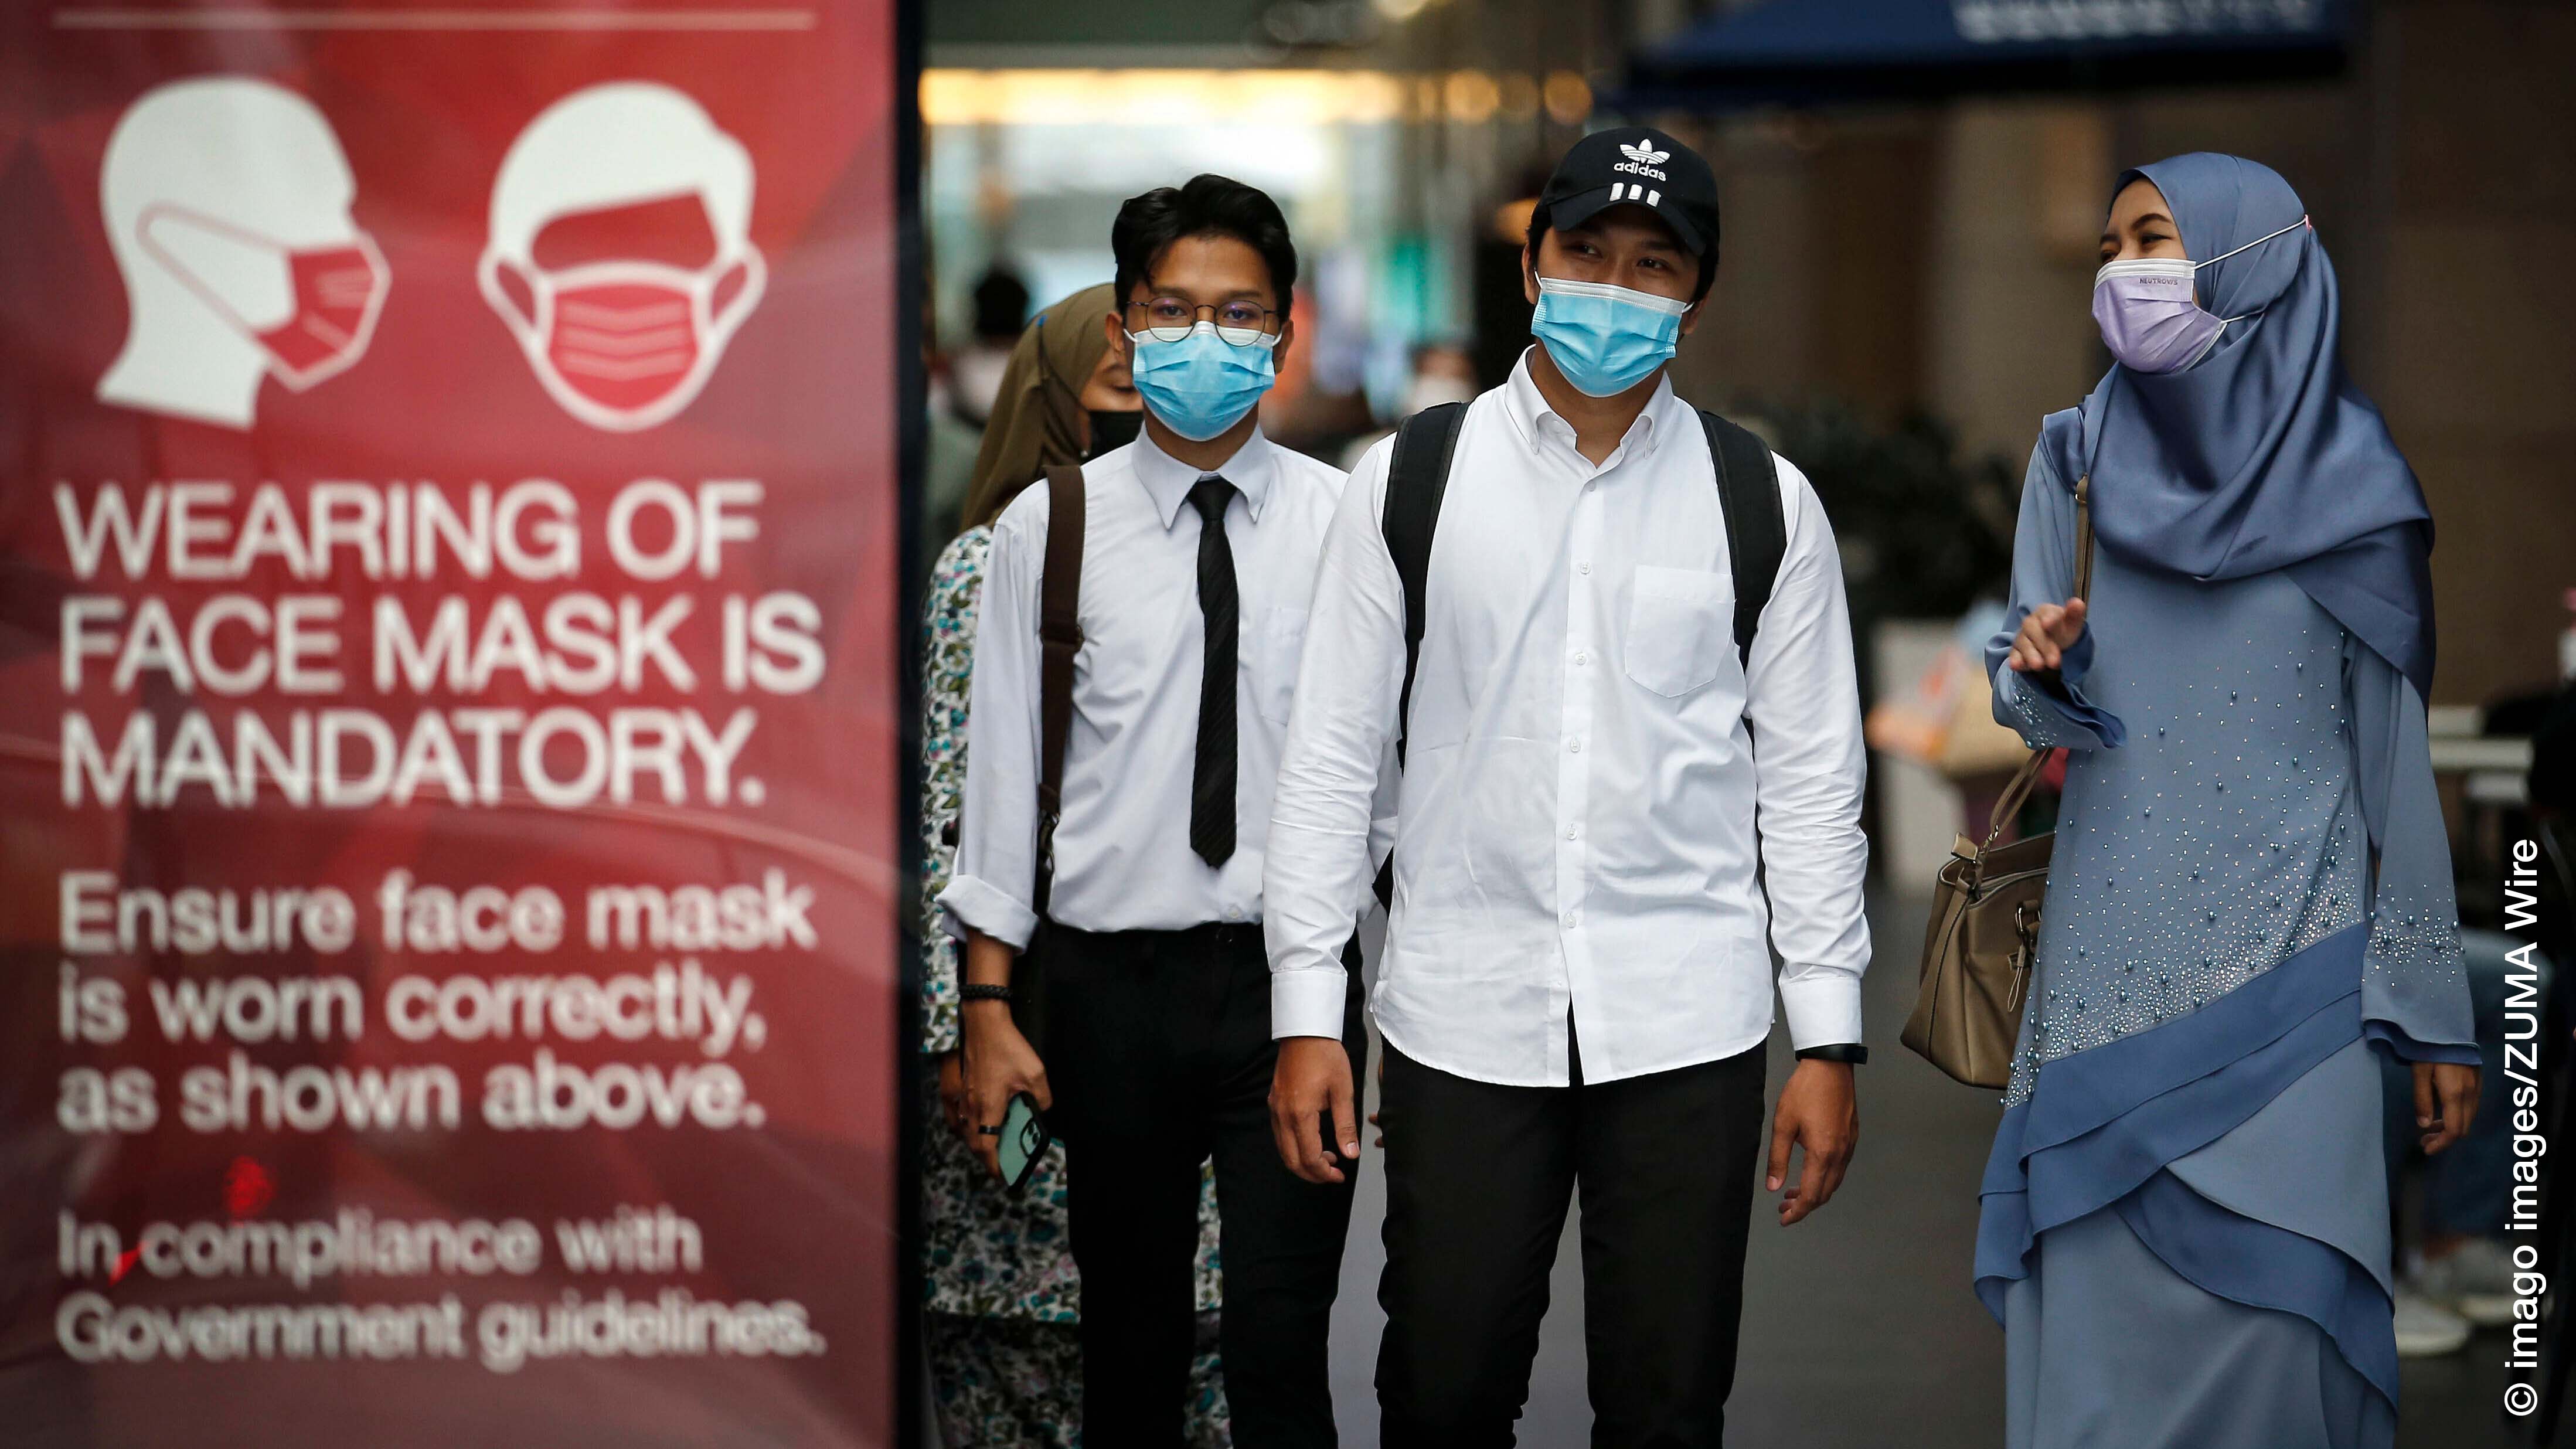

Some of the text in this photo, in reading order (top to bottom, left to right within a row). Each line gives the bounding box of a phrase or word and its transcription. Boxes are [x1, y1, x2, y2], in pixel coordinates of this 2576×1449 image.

[1614, 162, 1666, 182] adidas
[54, 479, 764, 579] WEARING OF
[60, 591, 826, 695] FACE MASK IS
[60, 708, 767, 810] MANDATORY.
[59, 868, 817, 954] Ensure face mask
[59, 960, 767, 1056] is worn correctly,
[57, 1050, 765, 1134] as shown above.
[59, 1205, 702, 1287] In compliance with
[57, 1288, 825, 1373] Government guidelines.
